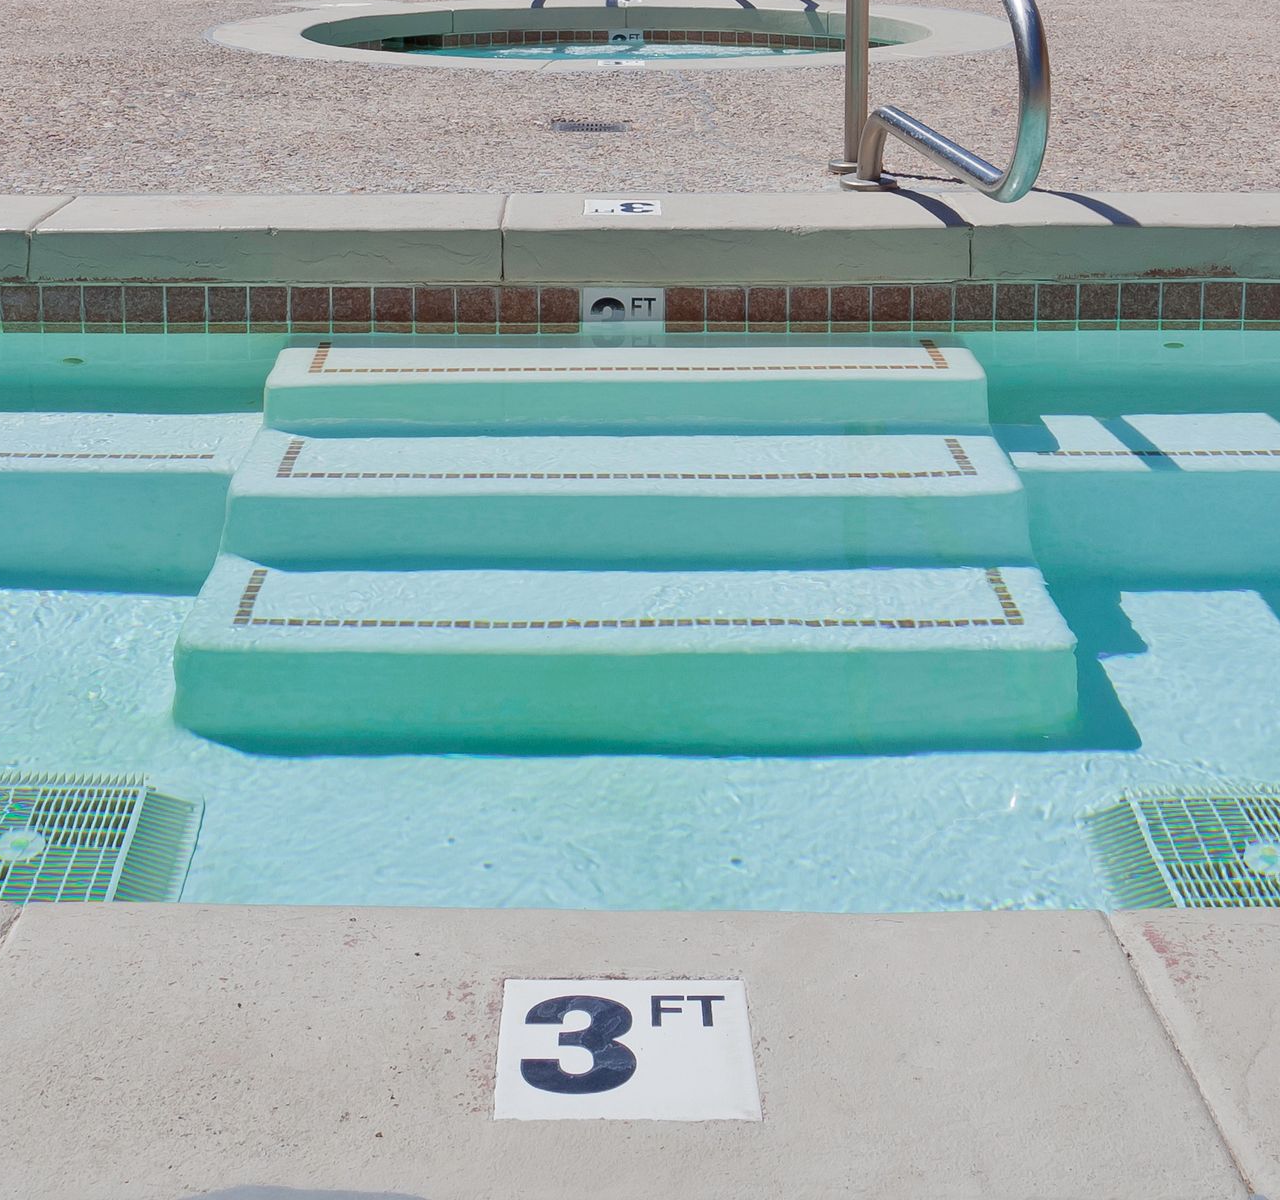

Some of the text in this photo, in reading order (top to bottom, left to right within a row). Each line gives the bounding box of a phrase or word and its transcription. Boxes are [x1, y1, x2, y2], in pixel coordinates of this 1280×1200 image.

[631, 297, 656, 317] FT
[520, 995, 725, 1094] 3 FT
